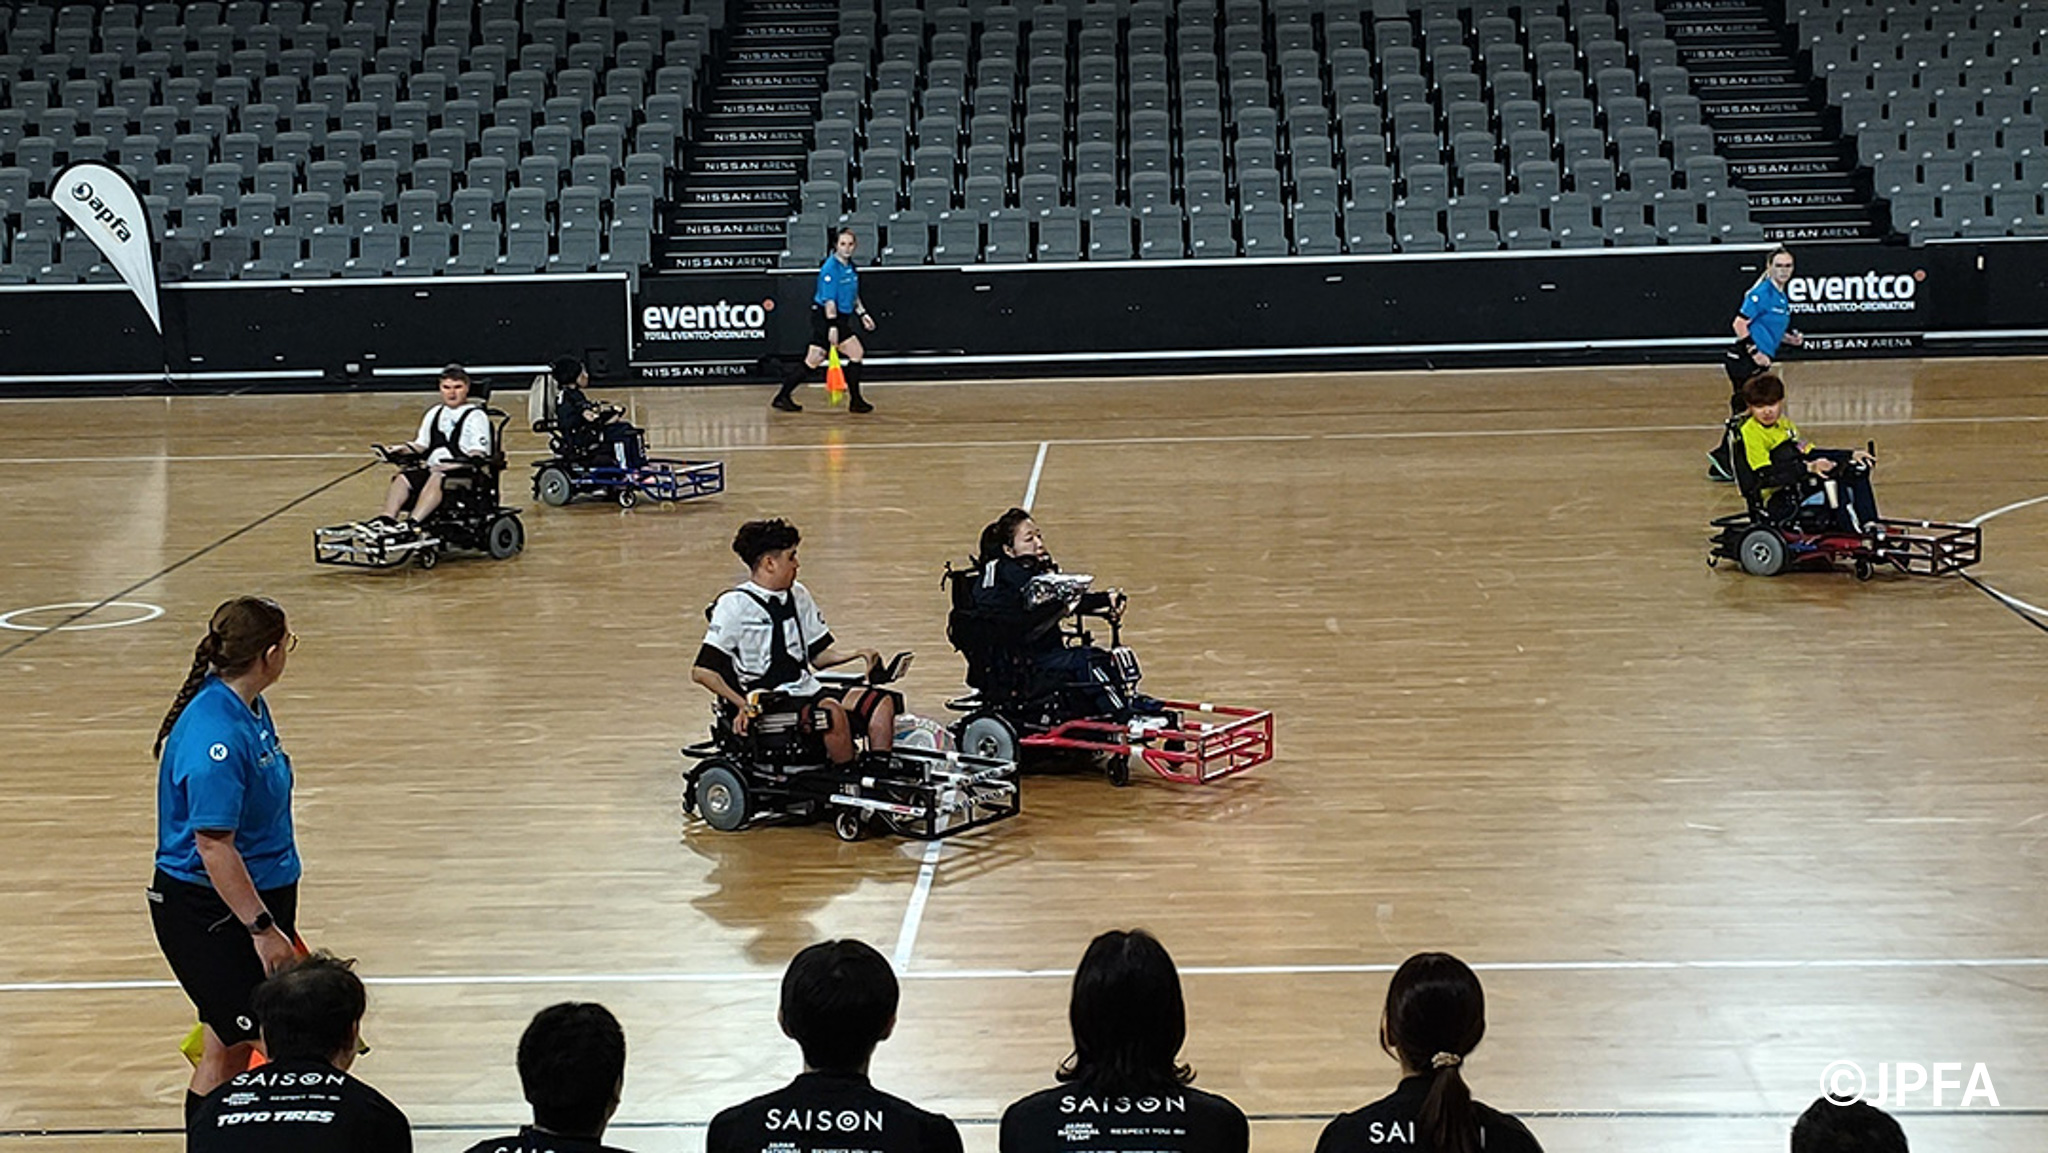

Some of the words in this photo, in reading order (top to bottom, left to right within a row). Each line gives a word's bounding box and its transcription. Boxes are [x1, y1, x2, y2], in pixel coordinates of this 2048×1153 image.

[738, 52, 790, 60] NISSAN
[732, 77, 782, 85] NISSAN
[784, 76, 816, 84] ARENA
[722, 104, 774, 112] NISSAN
[776, 104, 810, 112] ARENA
[1705, 105, 1760, 114] NISSAN
[1763, 104, 1798, 112] ARENA
[714, 132, 767, 141] NISSAN
[770, 132, 804, 140] ARENA
[1717, 134, 1774, 144] NISSAN
[1776, 133, 1812, 142] ARENA
[704, 161, 760, 170] NISSAN
[762, 160, 796, 169] ARENA
[1731, 164, 1789, 174] NISSAN
[1791, 163, 1829, 172] ARENA
[696, 192, 750, 201] NISSAN
[754, 192, 790, 200] ARENA
[1804, 194, 1843, 204] ARENA
[88, 196, 132, 243] apfa
[686, 224, 743, 234] NISSAN
[746, 224, 782, 233] ARENA
[1821, 228, 1860, 237] ARENA
[676, 258, 734, 267] NISSAN
[736, 257, 773, 267] ARENA
[1788, 270, 1916, 300] eventco
[1788, 304, 1816, 314] TOTAL
[643, 300, 765, 330] eventco
[644, 331, 671, 341] TOTAL
[1803, 338, 1869, 350] NISSAN
[1871, 338, 1912, 348] ARENA
[642, 366, 704, 377] NISSAN
[707, 366, 746, 376] ARENA
[232, 1072, 346, 1086] SAISON
[1060, 1096, 1186, 1113] SAISON
[217, 1112, 270, 1128] TOYO
[273, 1110, 336, 1123] TIRES
[765, 1108, 883, 1132] SAISON
